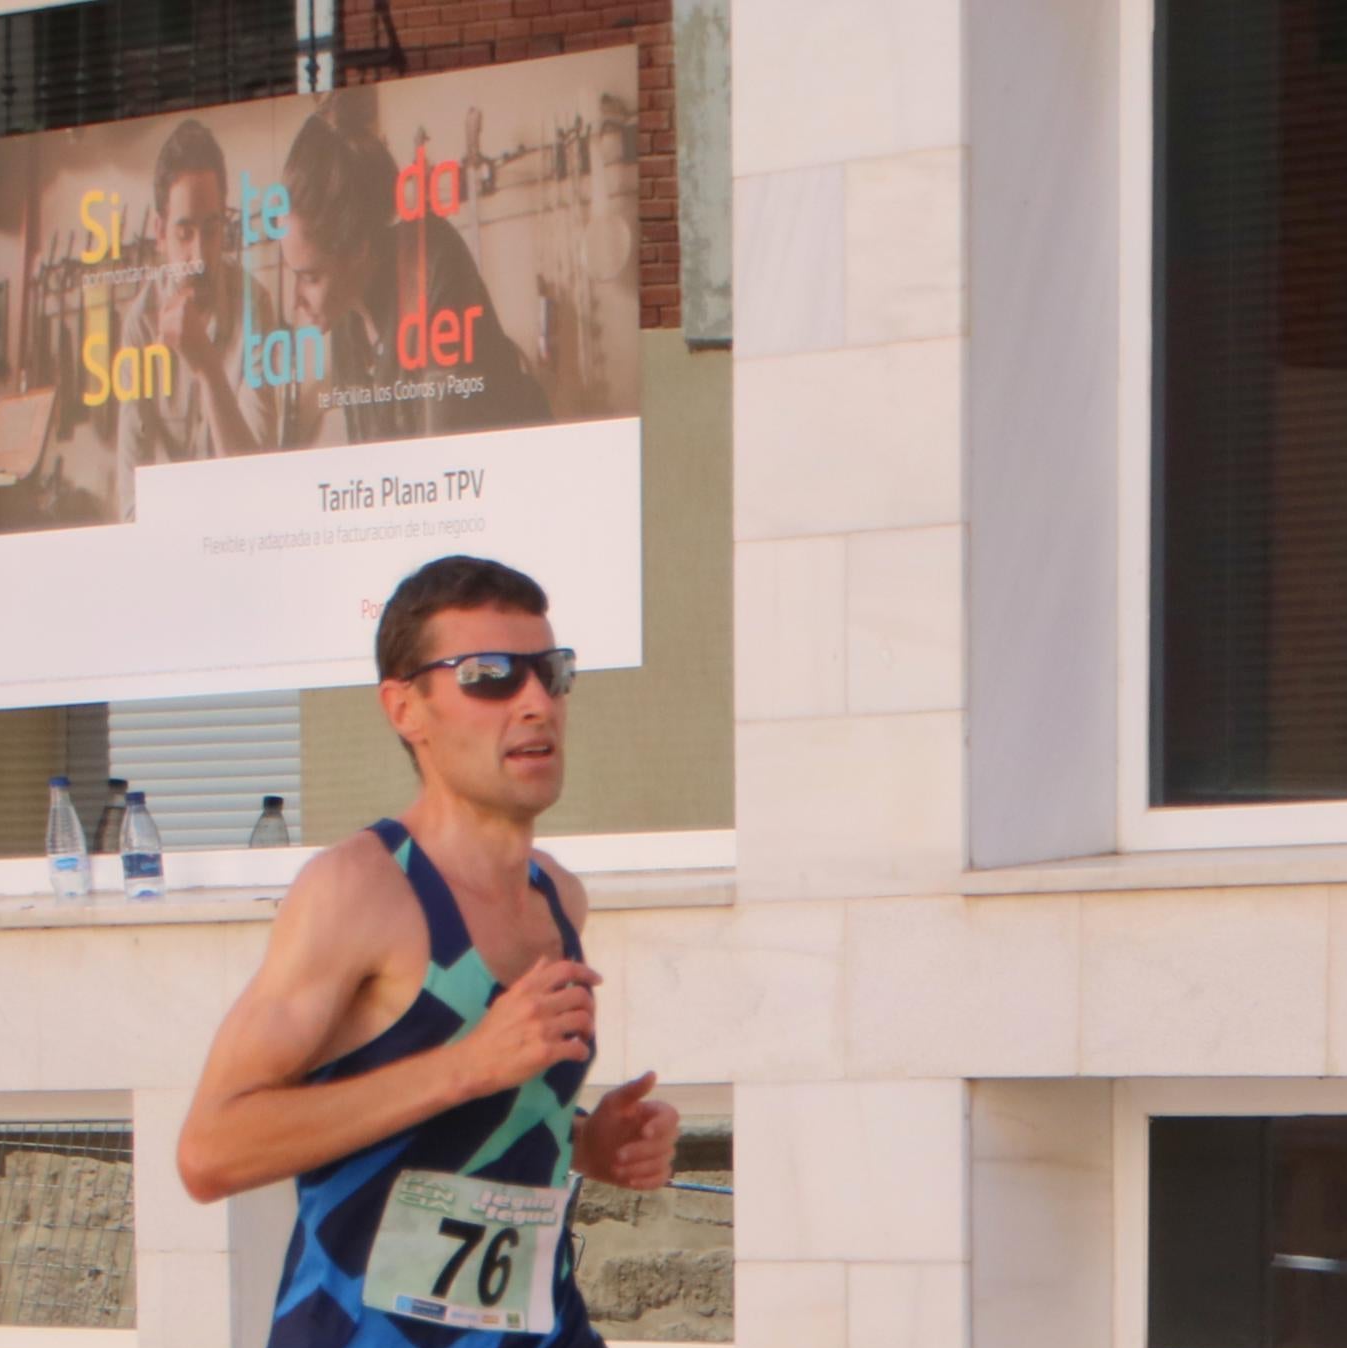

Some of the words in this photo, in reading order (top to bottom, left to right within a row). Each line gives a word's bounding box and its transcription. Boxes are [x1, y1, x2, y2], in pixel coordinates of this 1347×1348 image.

[241, 171, 291, 246] te
[395, 145, 461, 222] da
[80, 189, 121, 265] Si
[82, 334, 172, 407] San
[242, 312, 325, 389] tan
[397, 295, 484, 371] der
[318, 391, 330, 409] te
[332, 384, 372, 406] facilita
[374, 384, 391, 402] los
[395, 380, 435, 400] Cobros
[437, 384, 445, 399] y
[448, 374, 484, 396] Pagos
[318, 480, 375, 513] Tarifa
[382, 475, 438, 507] Plana
[444, 469, 485, 500] TPV
[248, 538, 256, 554] y
[258, 530, 312, 551] adaptada
[313, 532, 321, 546] a
[323, 529, 334, 545] la
[336, 521, 402, 544] facturación
[405, 520, 420, 539] de
[423, 520, 435, 536] tu
[438, 514, 485, 539] negocio
[431, 1216, 520, 1307] 76
